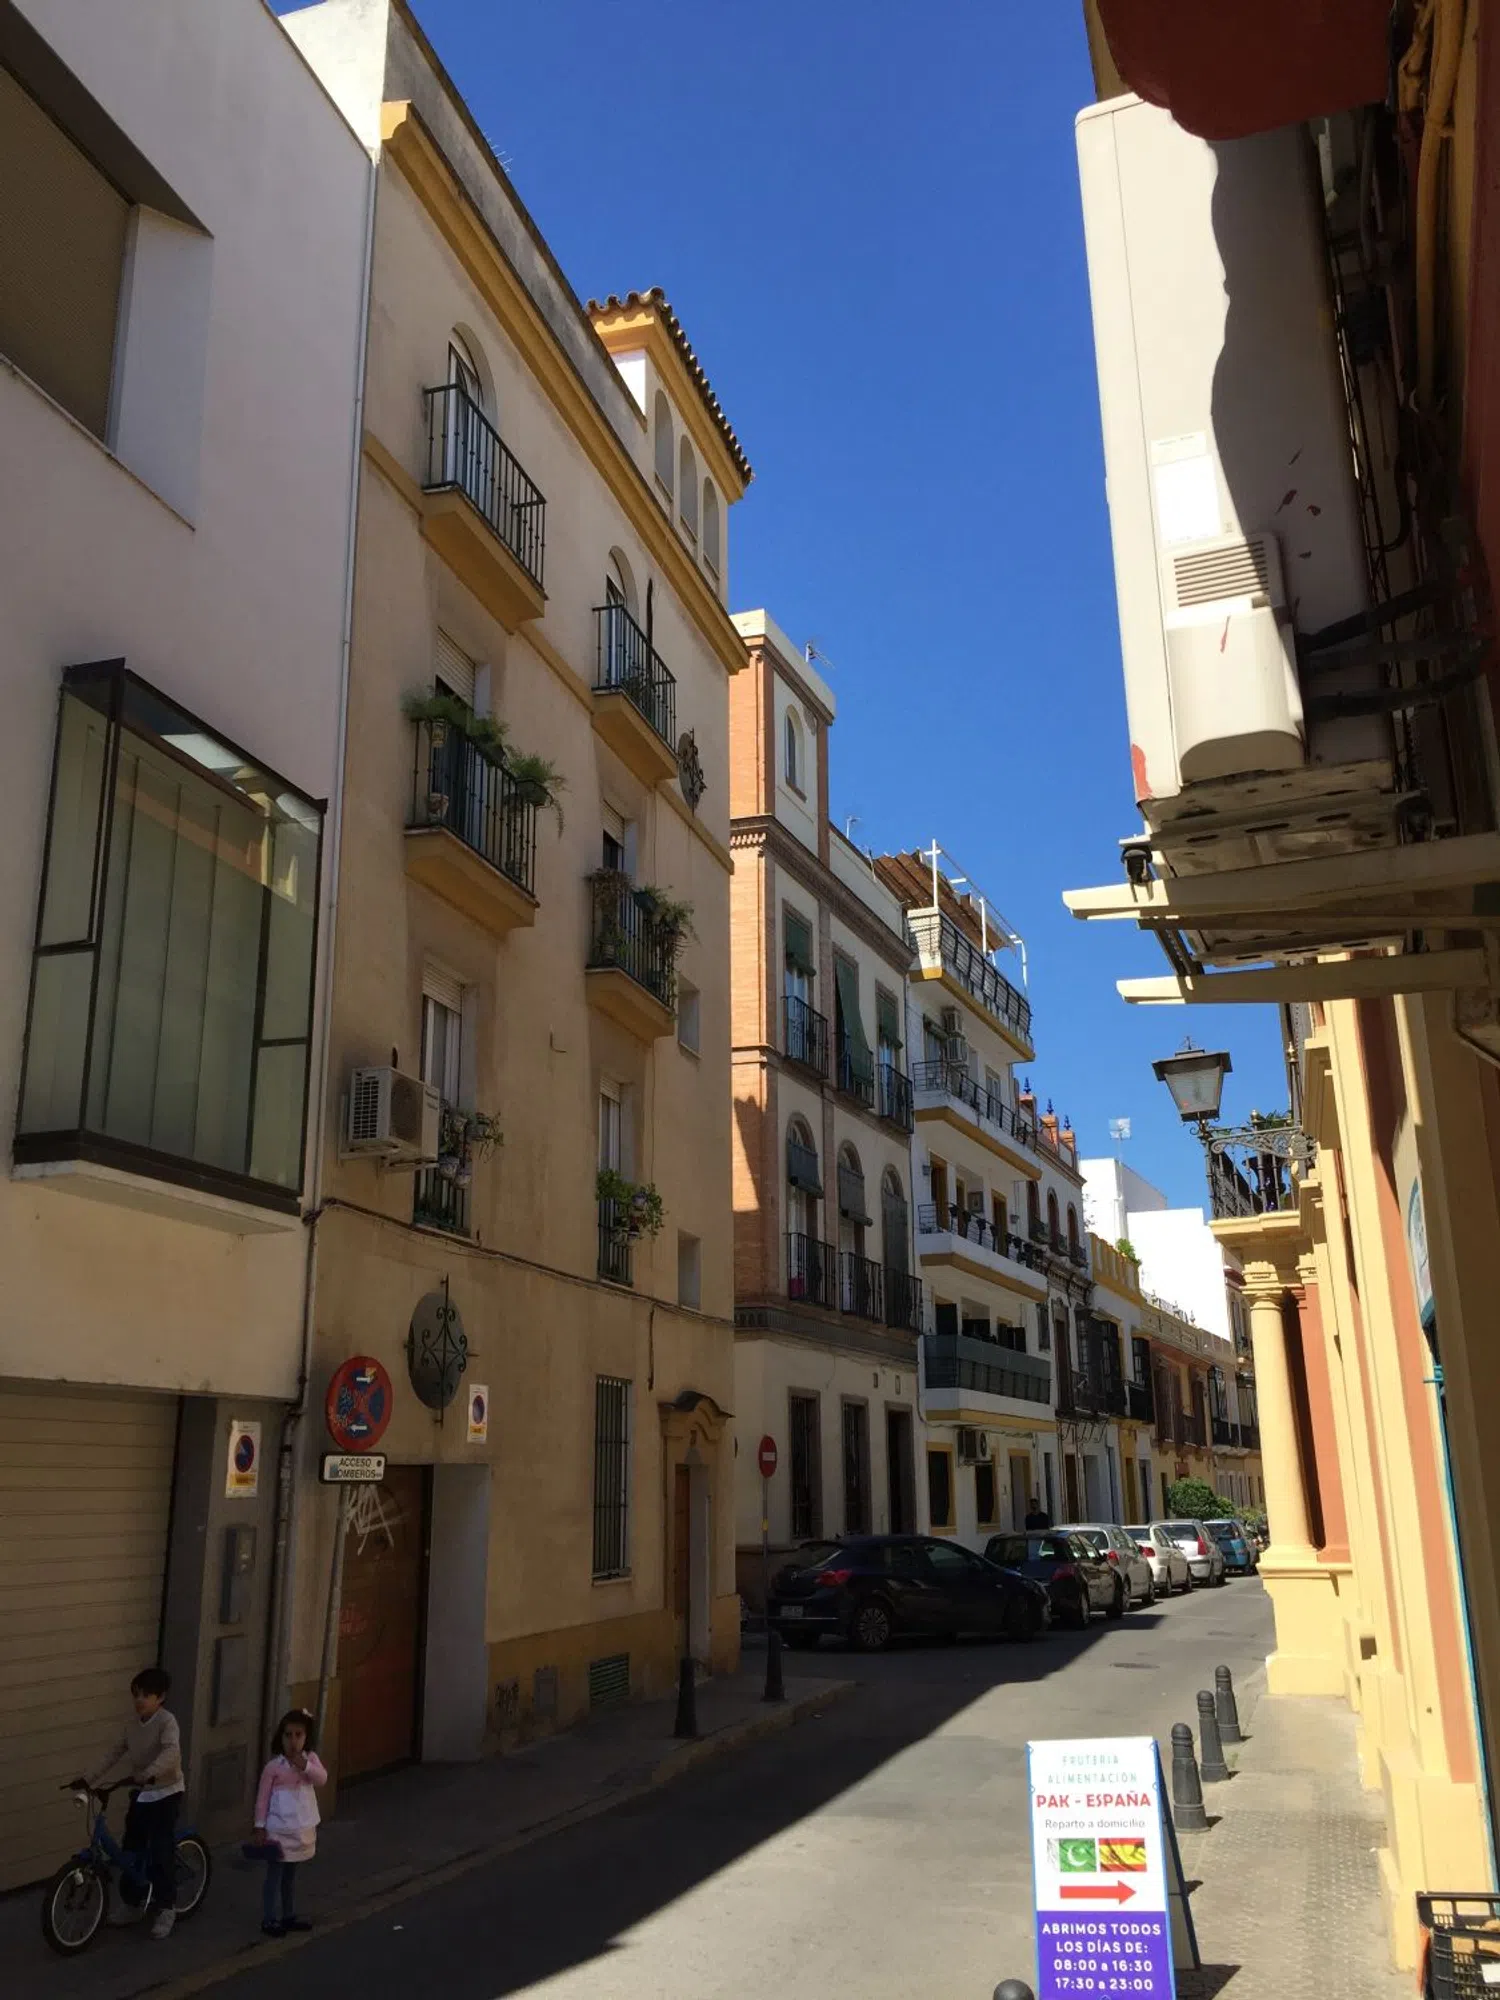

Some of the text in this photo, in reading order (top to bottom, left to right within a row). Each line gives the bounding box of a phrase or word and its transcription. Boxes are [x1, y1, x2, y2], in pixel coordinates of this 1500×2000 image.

[339, 1457, 372, 1467] ACCESO
[333, 1469, 376, 1478] OMBEROS
[1036, 1794, 1070, 1808] PAK
[1086, 1789, 1151, 1808] ESPAÑA
[1045, 1818, 1146, 1831] Reparto a domicilio
[1042, 1923, 1161, 1936] ABRIMOS TODOS
[1056, 1939, 1148, 1953] LOS DÍAS DE:
[1054, 1959, 1153, 1972] 08:00 a 16:30
[1055, 1977, 1153, 1990] 17:30 a 23:00
